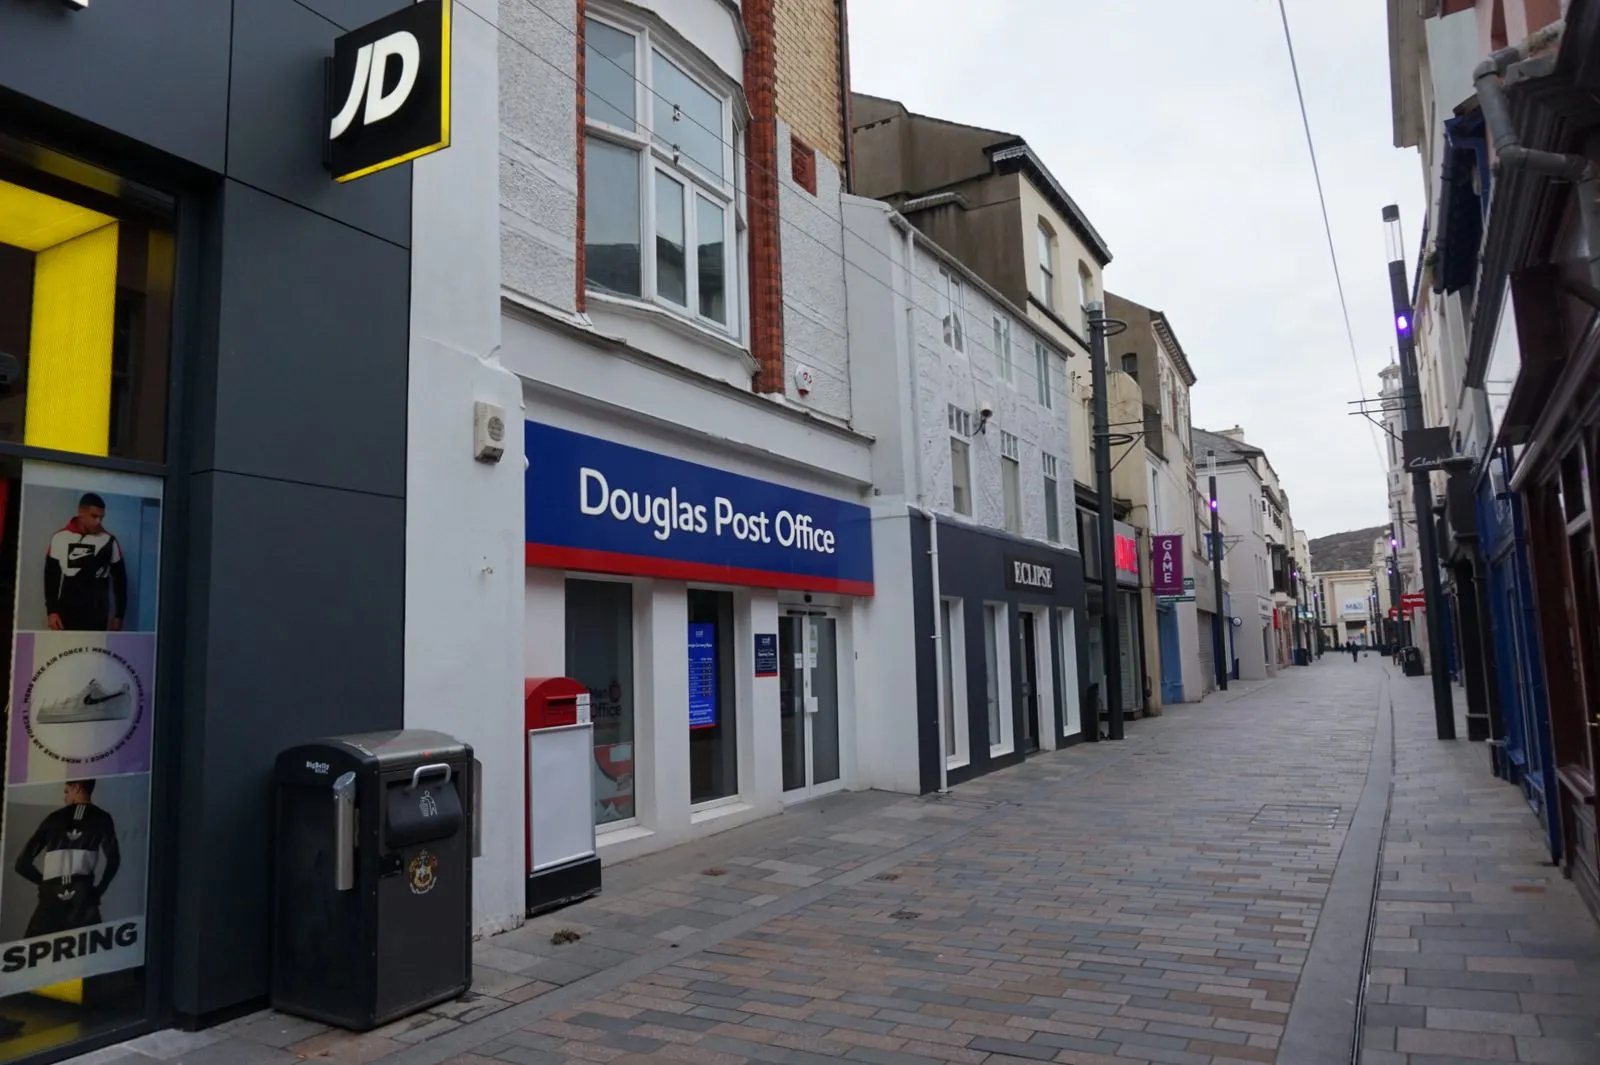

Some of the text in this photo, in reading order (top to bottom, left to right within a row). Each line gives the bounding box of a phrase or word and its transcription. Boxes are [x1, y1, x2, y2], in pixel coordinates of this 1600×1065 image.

[330, 31, 420, 140] JD
[579, 466, 836, 554] Douglas Post Office
[1013, 560, 1053, 588] ECLIPSE
[1162, 539, 1173, 584] GAME
[46, 656, 58, 667] AIR
[58, 647, 82, 659] FORCE
[1, 922, 138, 973] SPRING
